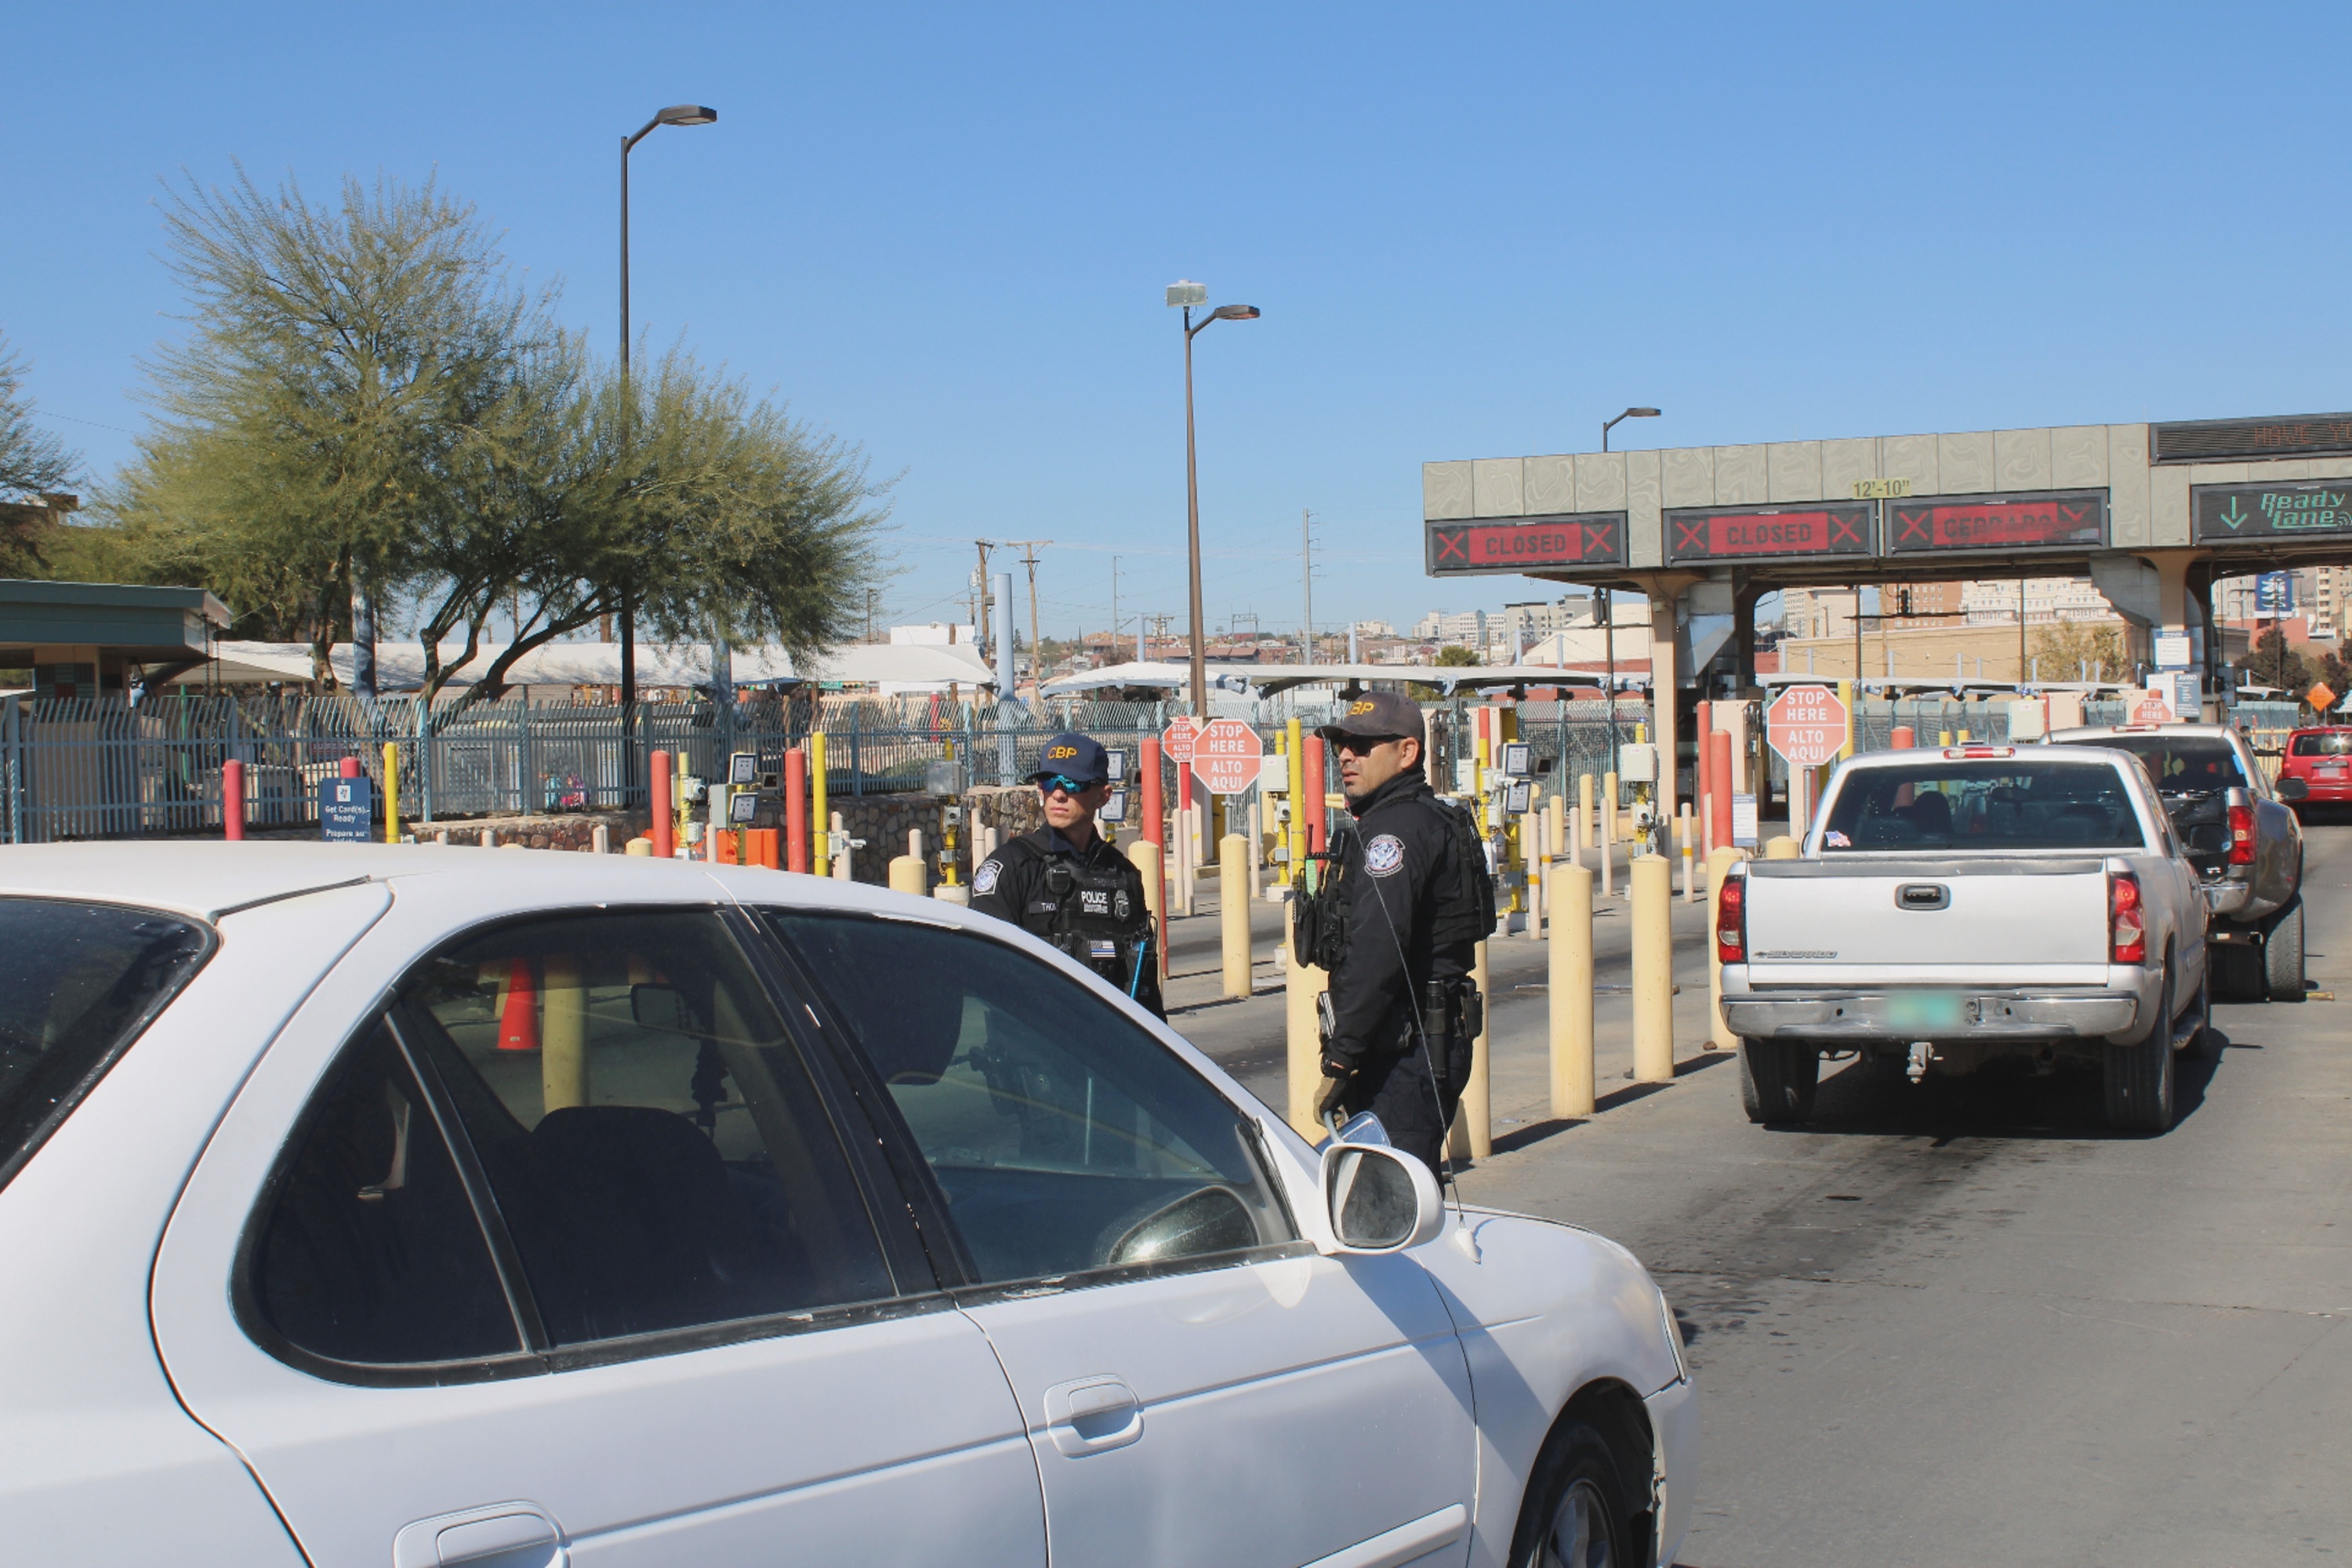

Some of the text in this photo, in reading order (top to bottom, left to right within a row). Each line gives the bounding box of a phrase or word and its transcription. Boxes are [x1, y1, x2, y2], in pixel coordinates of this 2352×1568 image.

[2260, 490, 2346, 517] Ready
[1726, 524, 1813, 545] CLOSED
[1486, 534, 1566, 555] CLOSED
[1787, 691, 1826, 705] STOP
[1787, 708, 1828, 720] HERE
[1210, 725, 1243, 738] STOP
[1788, 730, 1824, 744] ALTO
[1047, 746, 1078, 760] CBP
[1210, 740, 1245, 753] HERE
[1788, 746, 1824, 761] AQUI
[1173, 752, 1192, 760] AQUI
[1210, 760, 1243, 774] ALTO
[1210, 776, 1243, 790] AQUI
[333, 815, 356, 823] Ready
[326, 829, 354, 838] Prepare
[1081, 891, 1108, 904] POLICE
